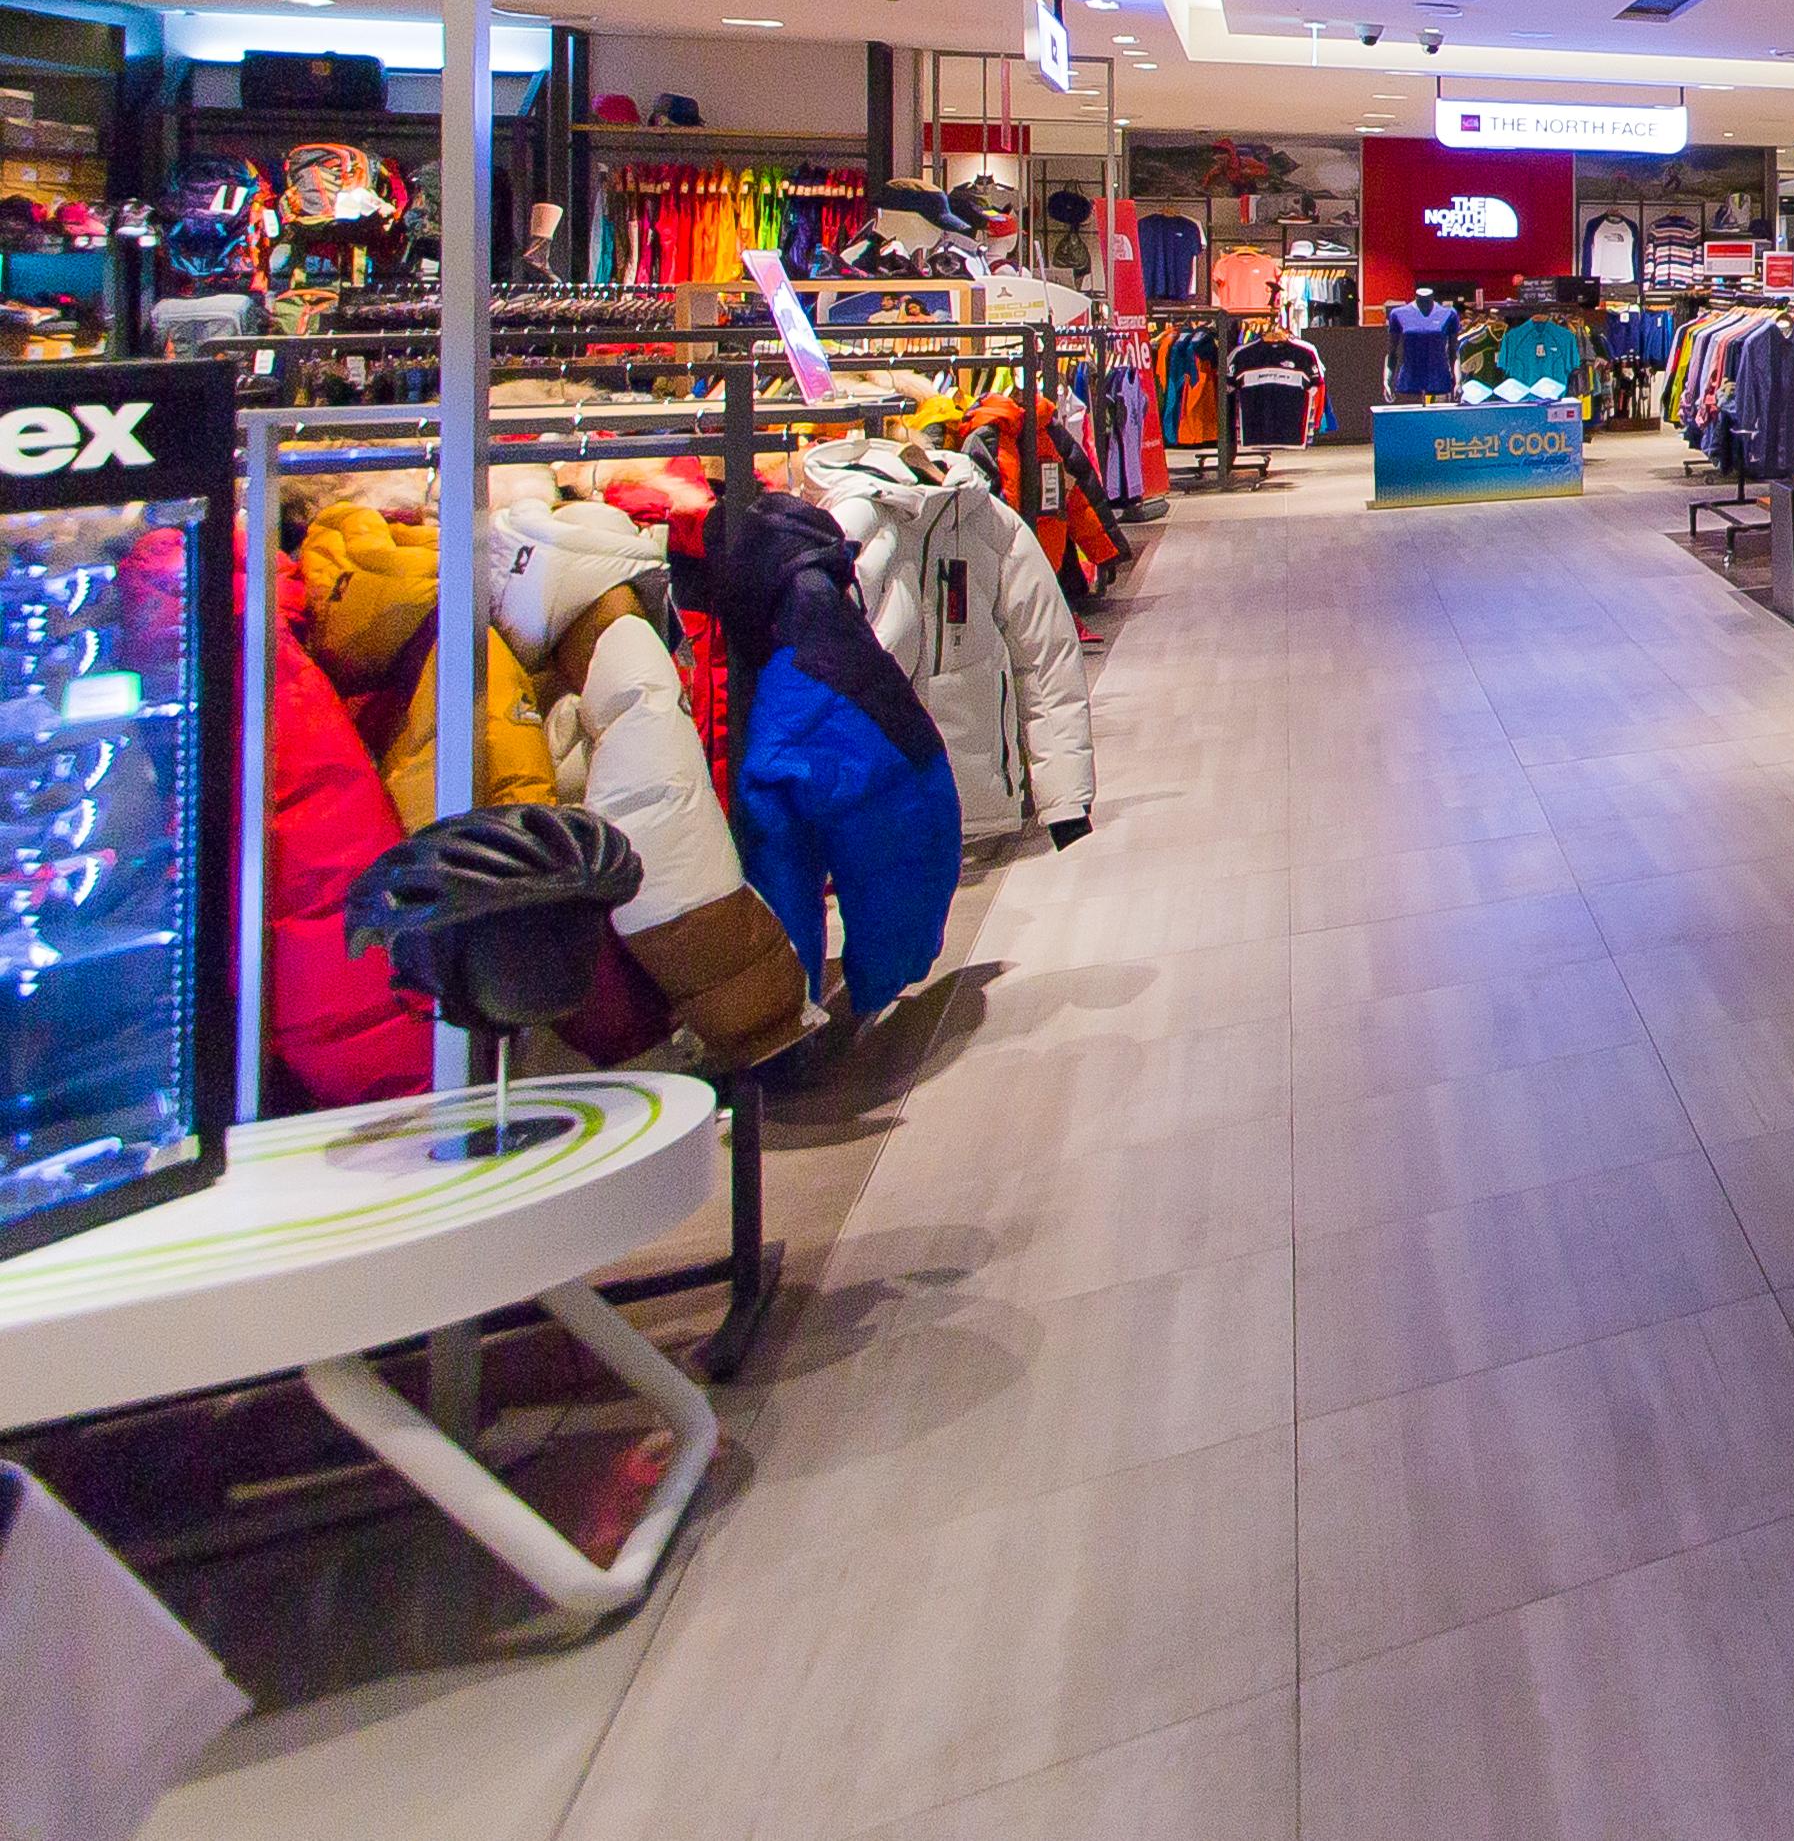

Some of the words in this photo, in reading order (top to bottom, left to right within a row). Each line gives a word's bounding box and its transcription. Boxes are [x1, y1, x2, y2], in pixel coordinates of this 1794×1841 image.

[1491, 116, 1527, 133] THE
[1535, 118, 1605, 135] NORTH
[1612, 121, 1658, 137] FACE
[1451, 196, 1485, 210] THE
[1424, 209, 1485, 224] NORTH
[1508, 430, 1575, 457] COOL
